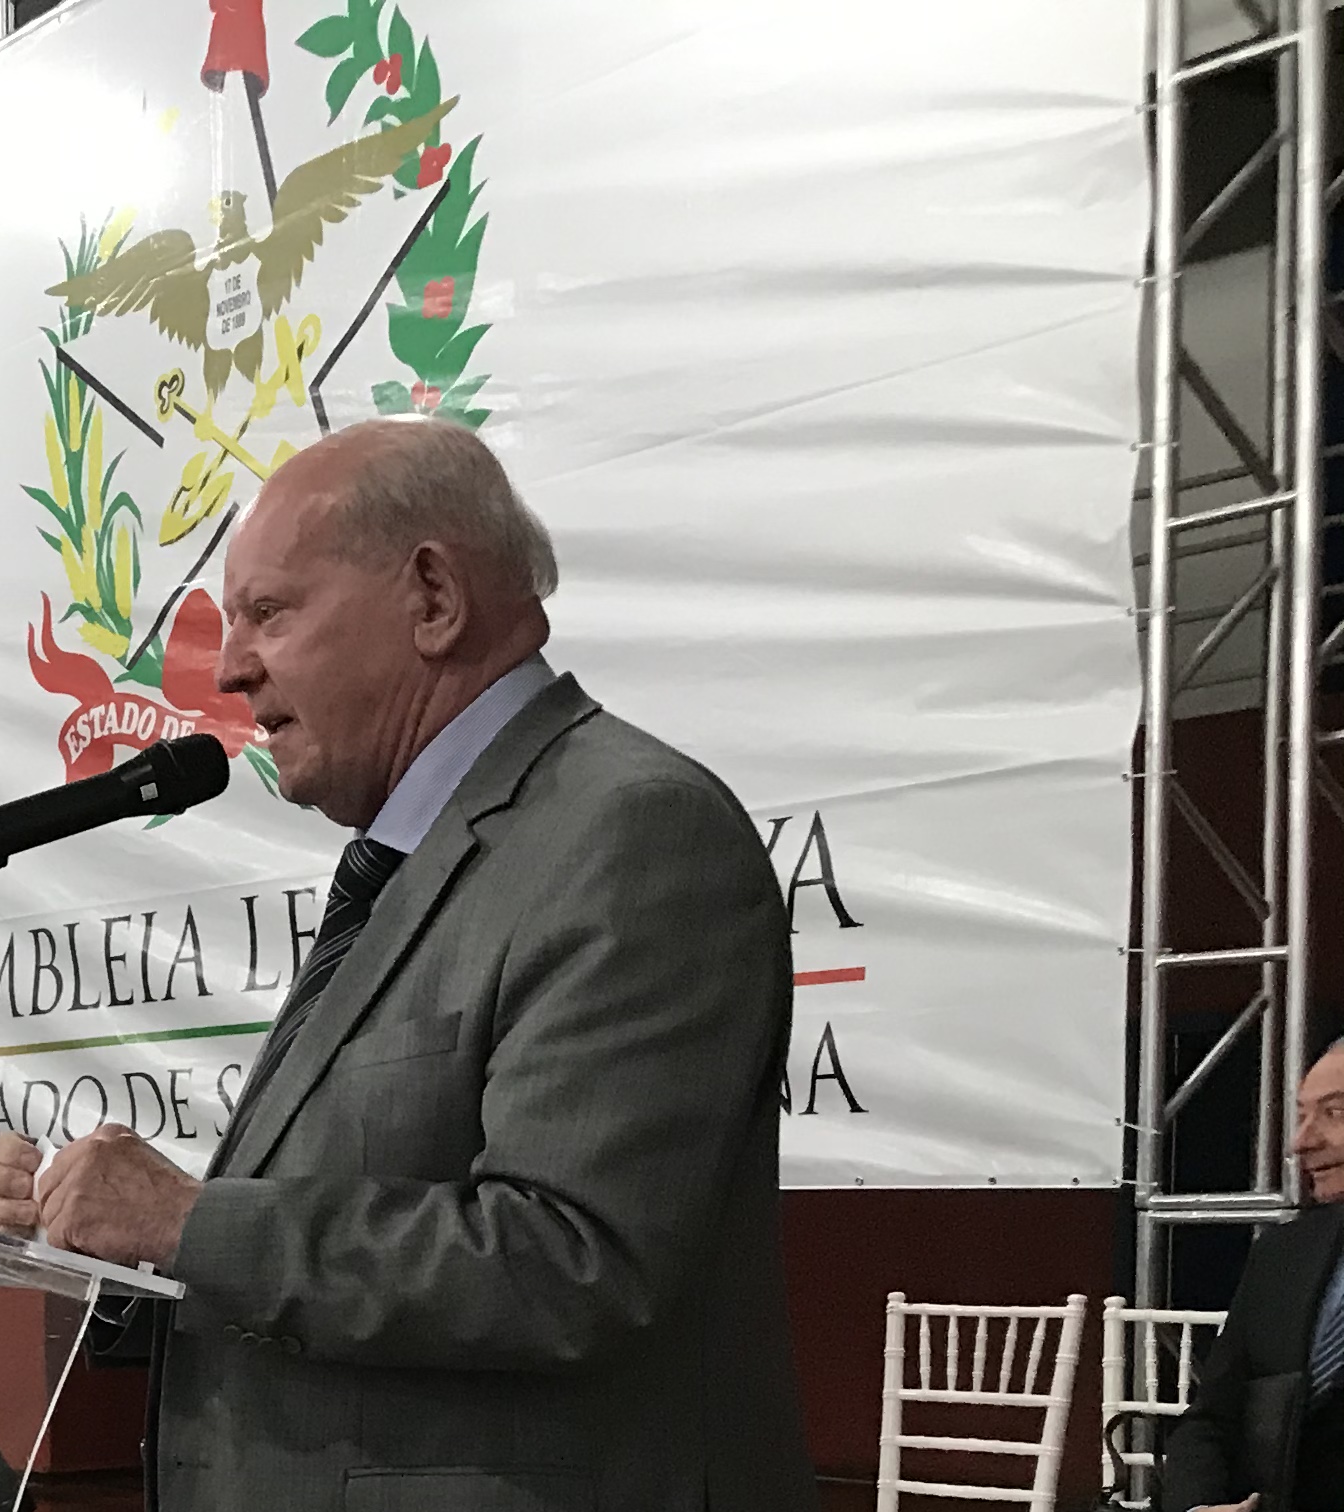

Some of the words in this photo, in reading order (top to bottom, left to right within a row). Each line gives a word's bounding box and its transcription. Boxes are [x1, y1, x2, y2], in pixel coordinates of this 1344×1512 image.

[233, 274, 241, 291] DE
[216, 290, 251, 317] NOVEMBRO
[221, 317, 231, 334] DE
[64, 702, 157, 764] ESTADO
[121, 1068, 197, 1141] DE
